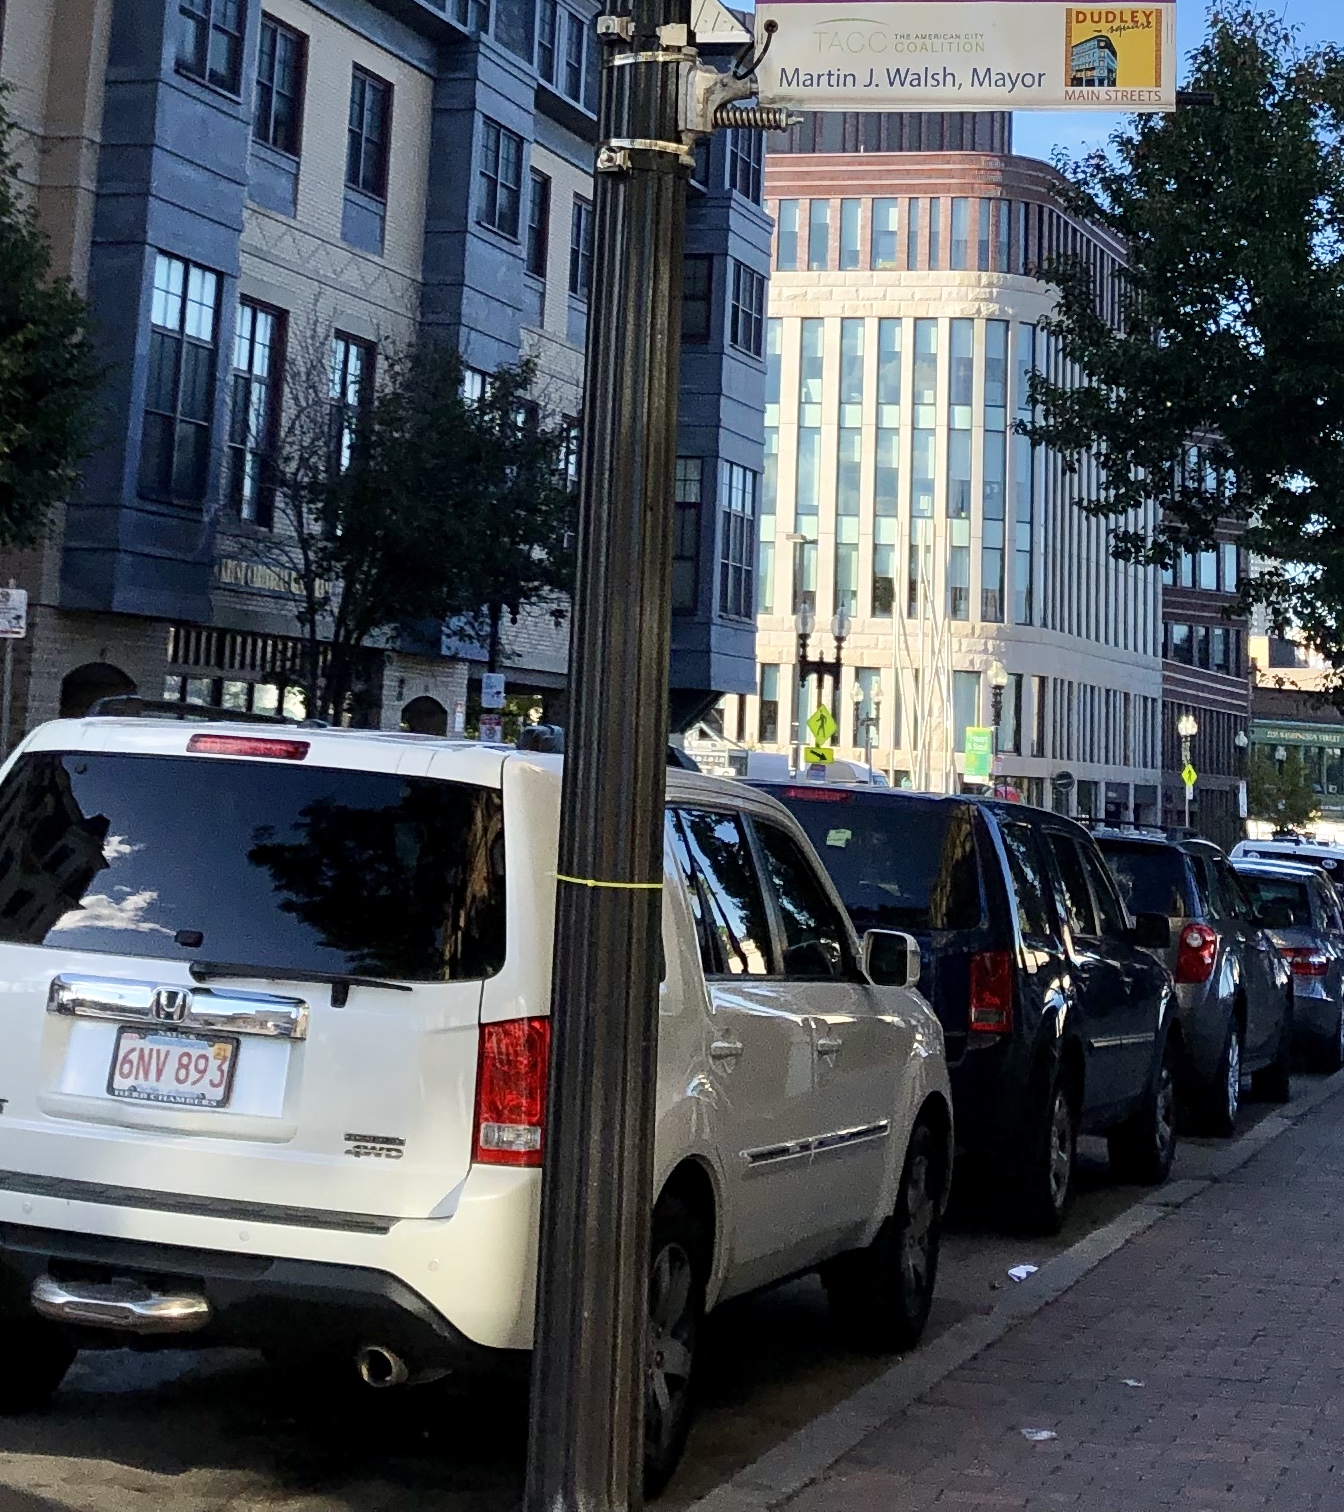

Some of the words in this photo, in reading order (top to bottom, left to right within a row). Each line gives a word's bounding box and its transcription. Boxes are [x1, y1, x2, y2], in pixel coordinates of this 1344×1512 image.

[1075, 10, 1154, 24] DUDLEY
[812, 31, 888, 54] TACC
[894, 33, 912, 41] THE
[914, 33, 962, 41] AMERICAN
[964, 33, 985, 41] CITY
[894, 41, 986, 54] COALITION
[779, 67, 858, 88] Martin
[863, 67, 880, 88] J.
[886, 67, 962, 91] Walsh,
[970, 68, 1047, 93] Mayor
[1064, 89, 1101, 101] MAIN
[1104, 90, 1162, 102] STREETS
[118, 1047, 171, 1083] 6NV
[174, 1051, 229, 1089] 893
[149, 1093, 218, 1107] CHAMBERS
